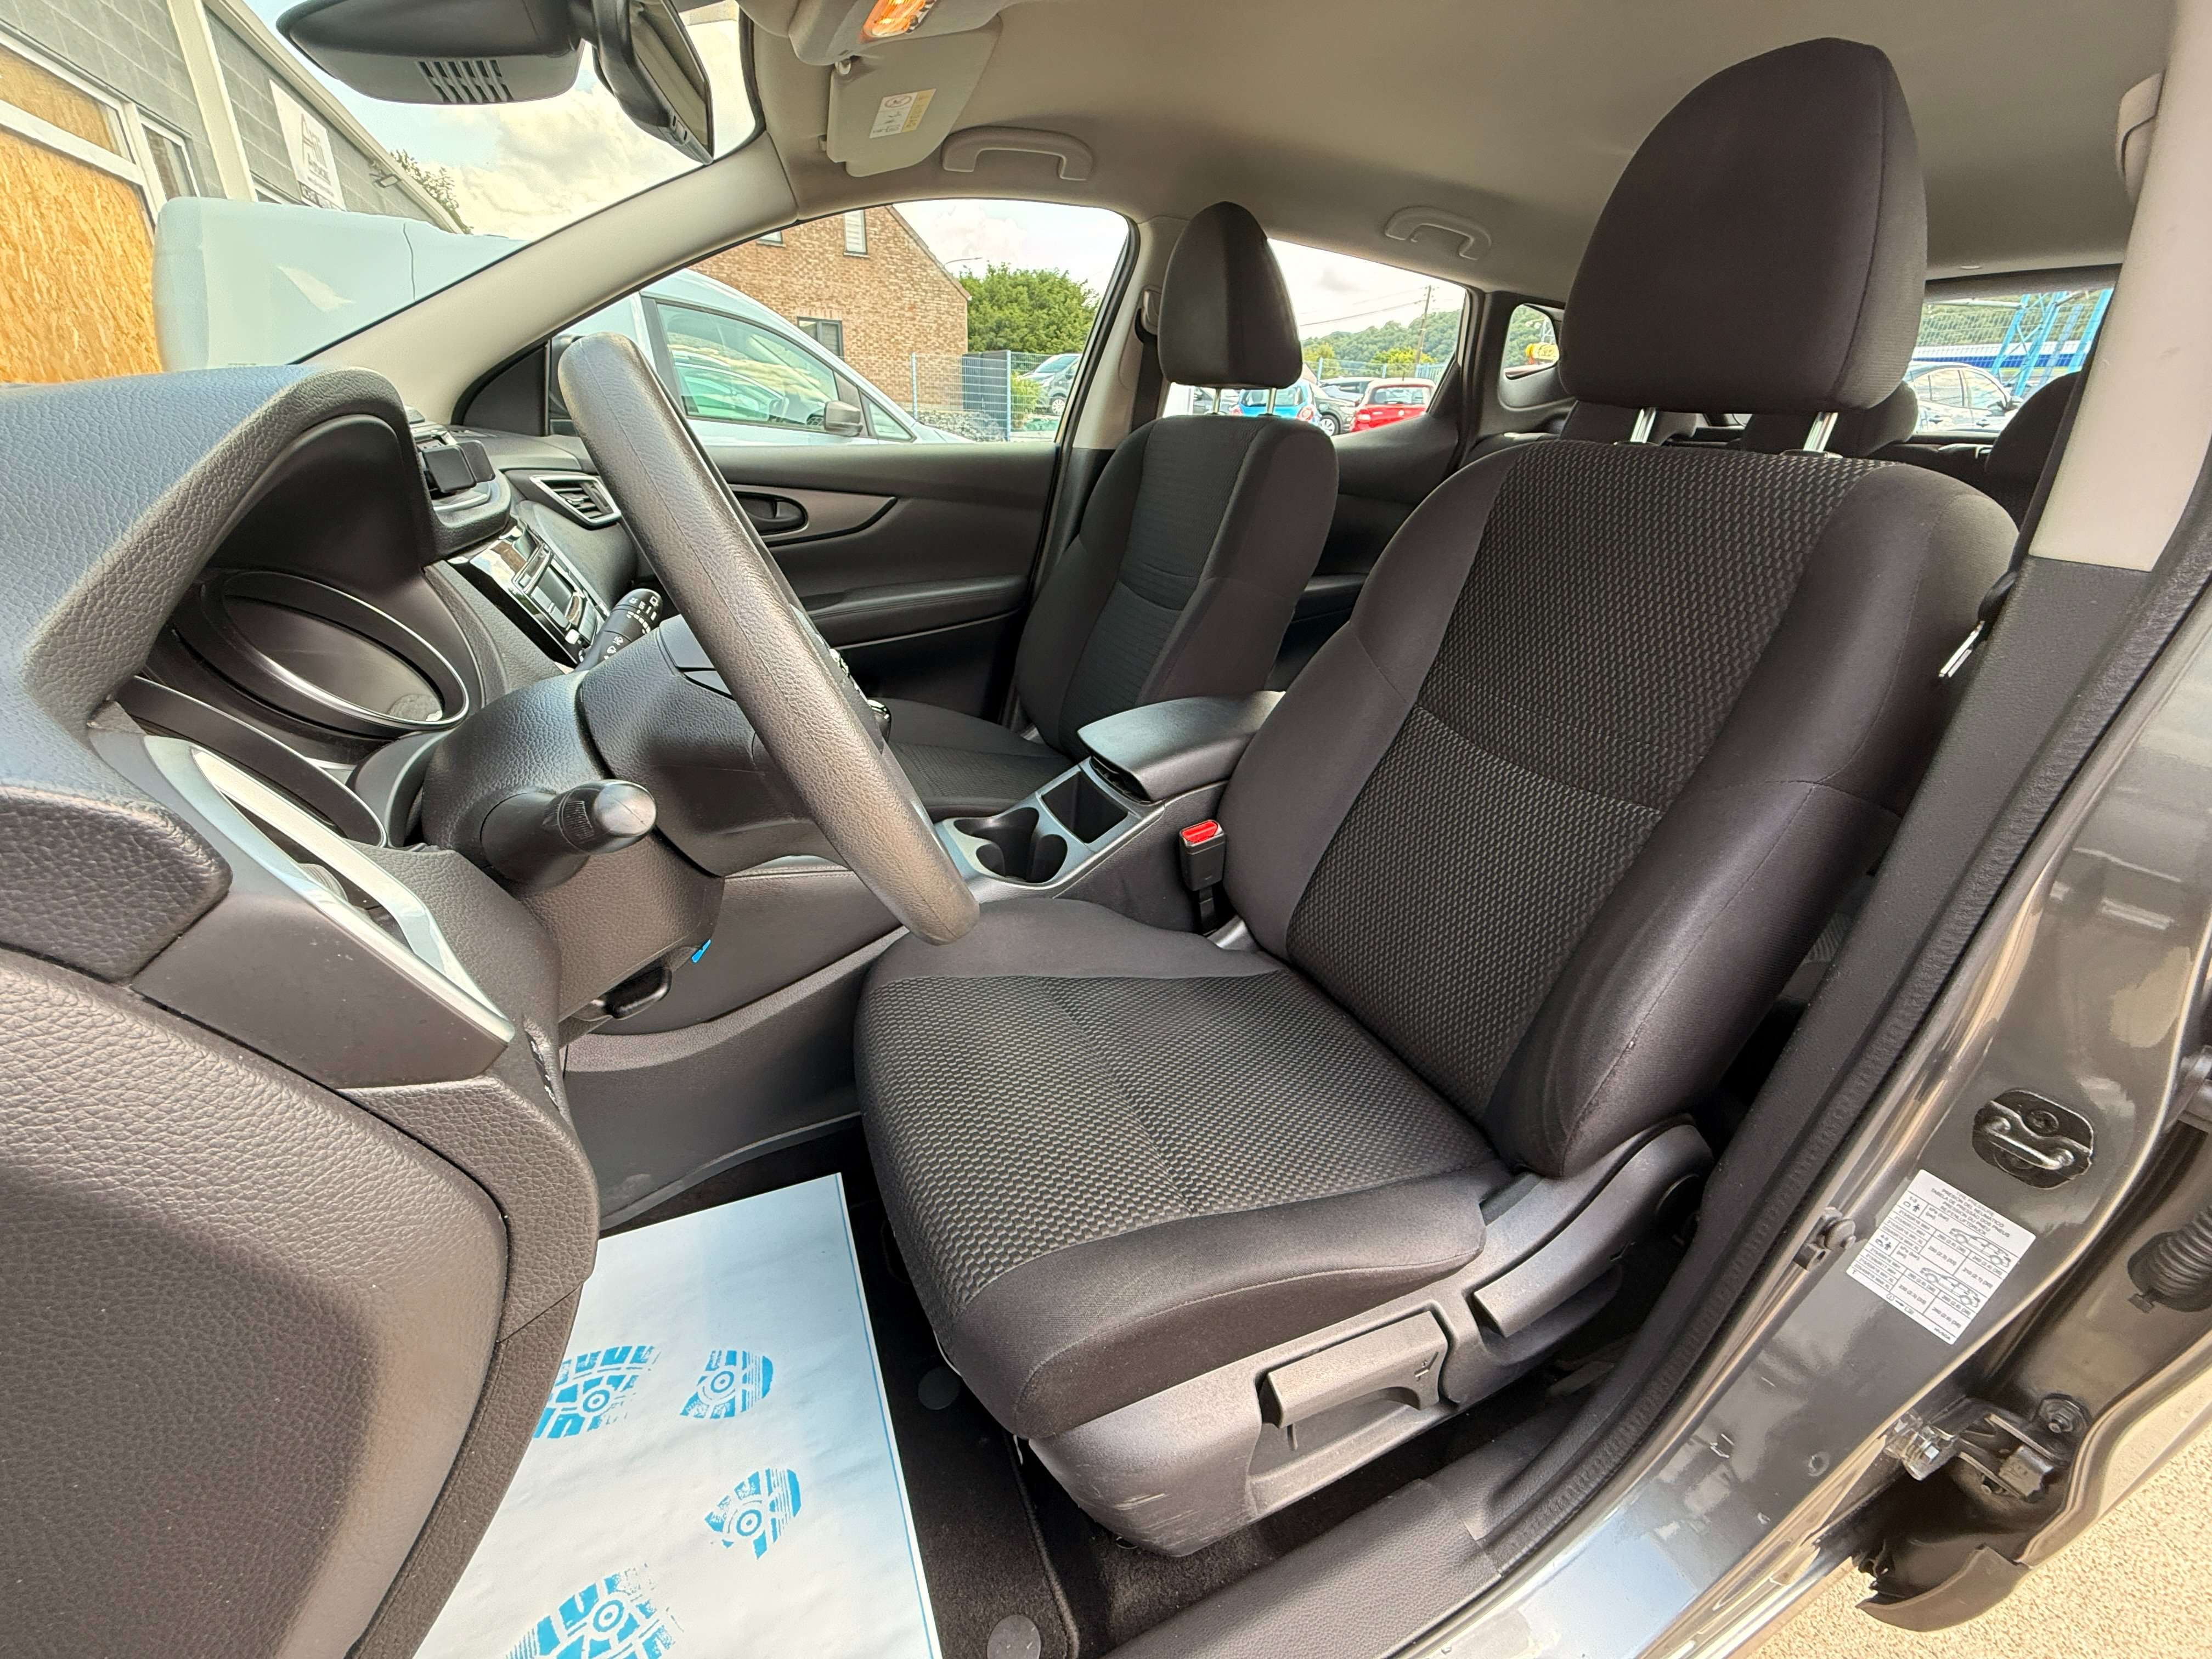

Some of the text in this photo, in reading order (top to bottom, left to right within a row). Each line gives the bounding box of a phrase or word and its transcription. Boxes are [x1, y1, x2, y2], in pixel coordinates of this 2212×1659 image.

[1931, 1188, 1948, 1200] TABELA
[1991, 1225, 2010, 1237] PNEUS
[1940, 1206, 1987, 1235] REIFENLUFTDRUCK
[1943, 1201, 1967, 1217] PRESSION
[1976, 1221, 1990, 1232] PNEU
[1967, 1199, 1994, 1216] PRESSURE
